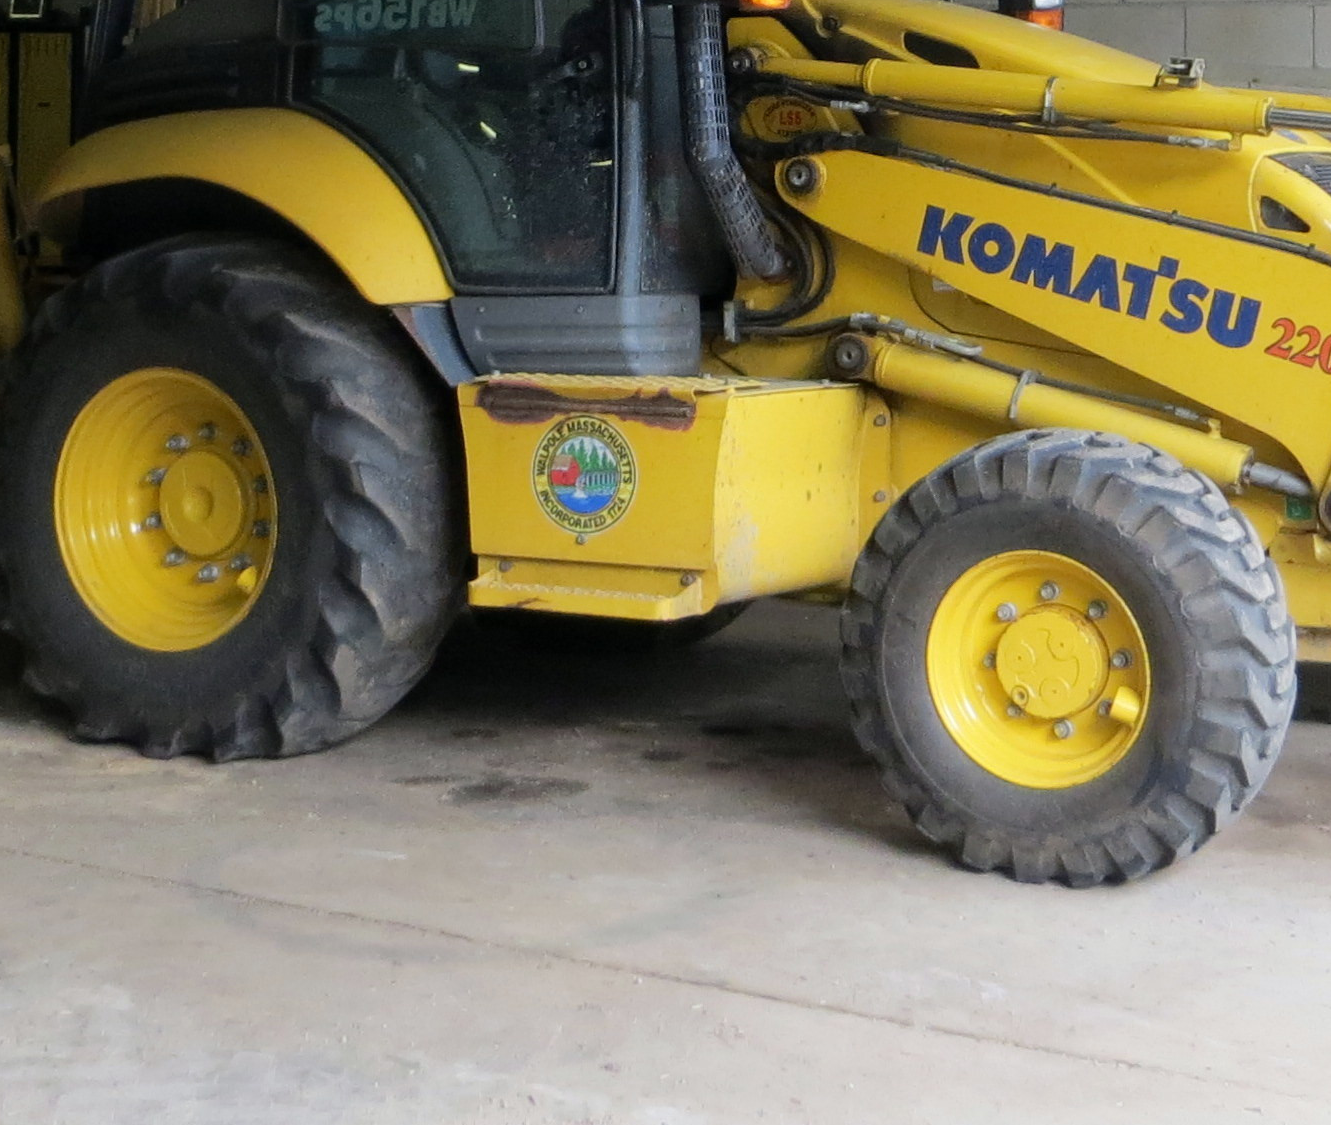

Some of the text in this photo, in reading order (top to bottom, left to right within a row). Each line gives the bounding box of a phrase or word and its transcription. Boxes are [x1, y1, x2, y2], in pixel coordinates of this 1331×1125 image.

[916, 204, 1263, 349] KOMATSU
[536, 419, 633, 485] WALPOLE MASSACHUSETTS
[539, 489, 607, 530] INCORPORATED
